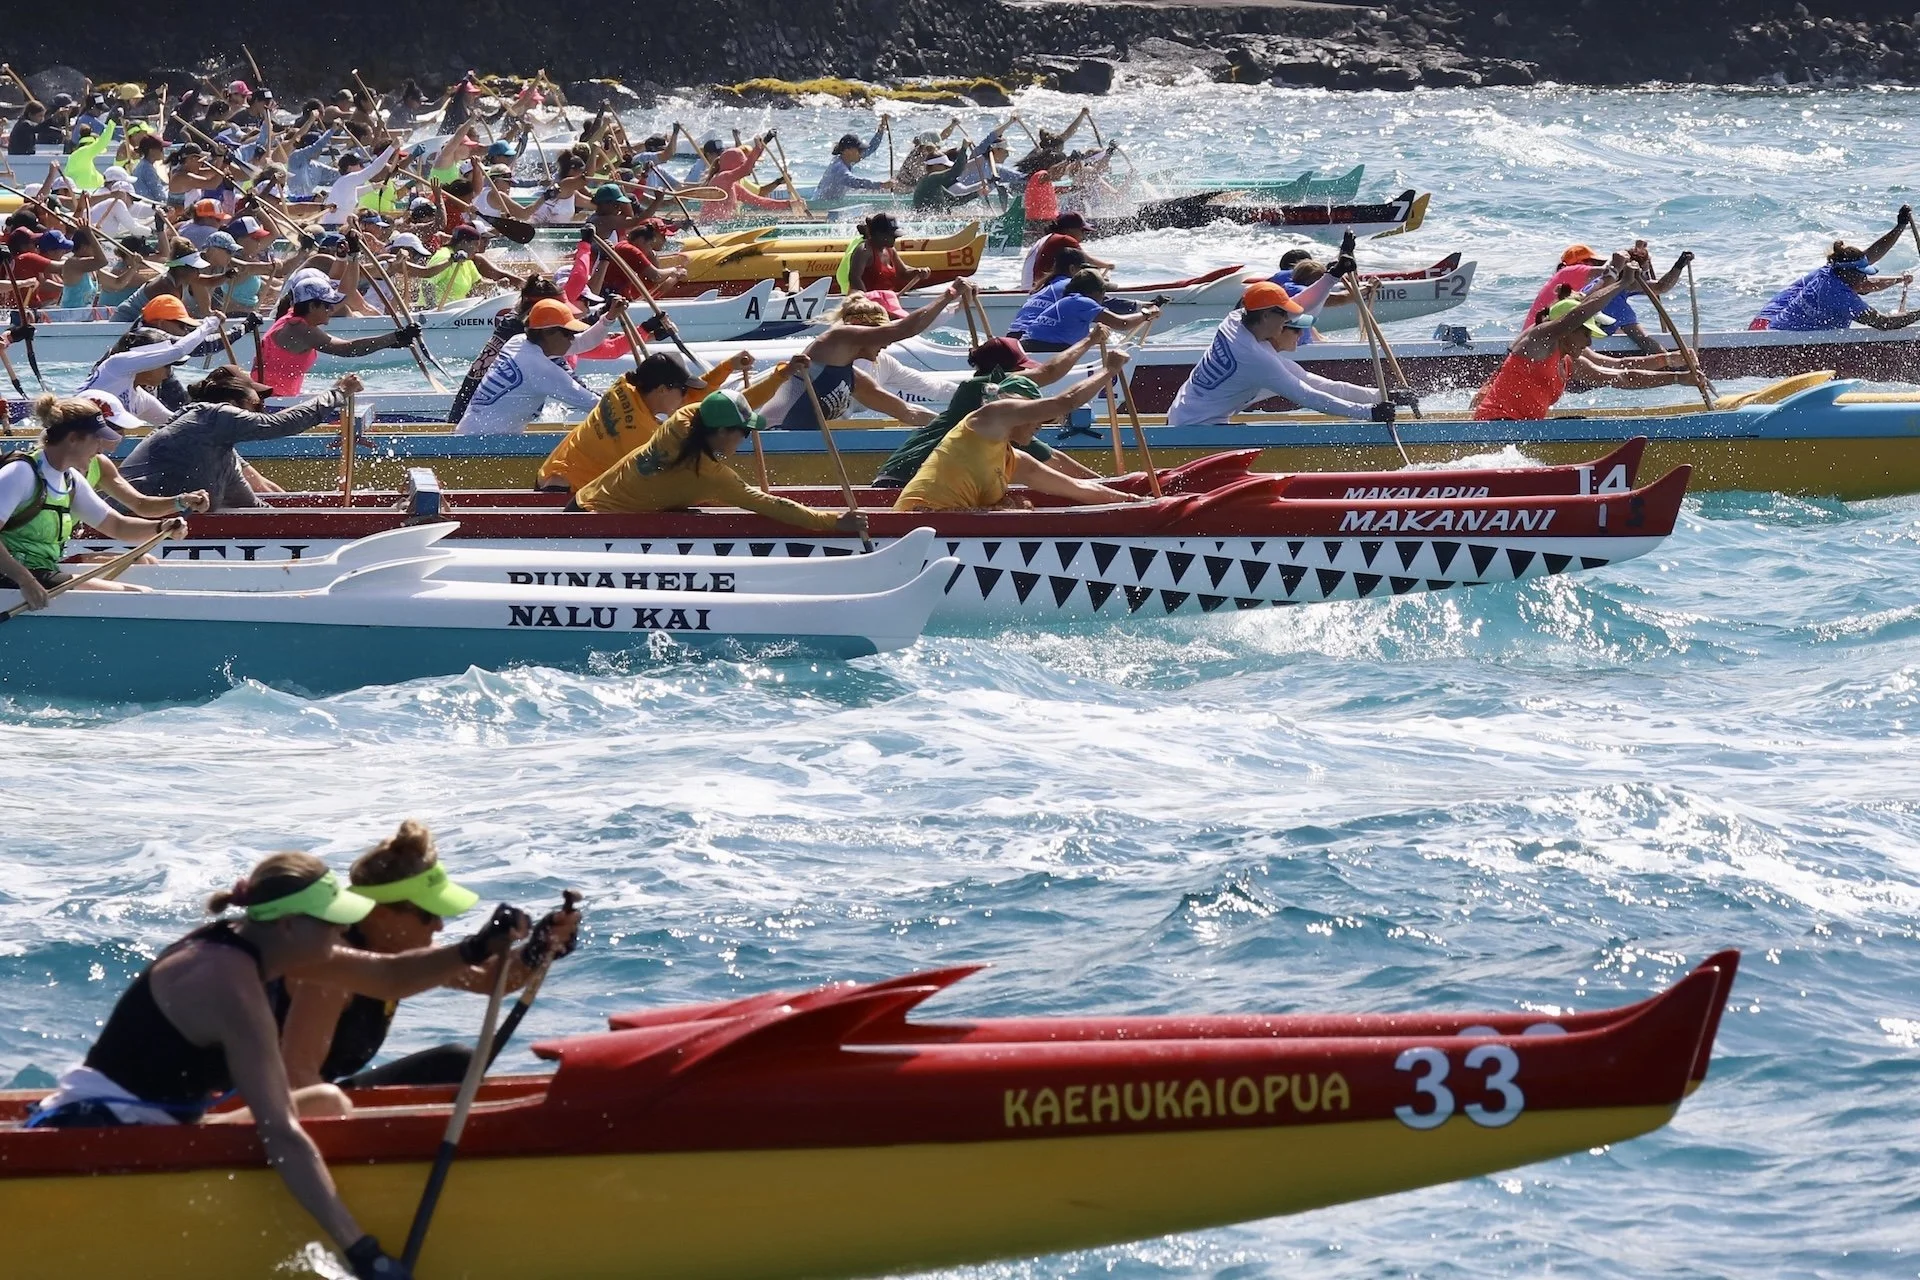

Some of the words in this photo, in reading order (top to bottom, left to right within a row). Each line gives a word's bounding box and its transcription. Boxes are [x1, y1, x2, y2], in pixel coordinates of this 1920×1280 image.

[1391, 201, 1410, 221] 7
[805, 259, 840, 273] Keau
[946, 246, 975, 267] E8
[1433, 274, 1468, 299] F2
[781, 297, 819, 320] A7
[453, 317, 485, 327] QUEEN
[1338, 509, 1557, 532] MAKANANI
[506, 571, 736, 593] PUNAHELE
[507, 605, 619, 629] NALU
[631, 607, 712, 631] KAI
[1393, 1043, 1526, 1131] 33
[1003, 1072, 1351, 1128] KAEHUKAIOPUA
